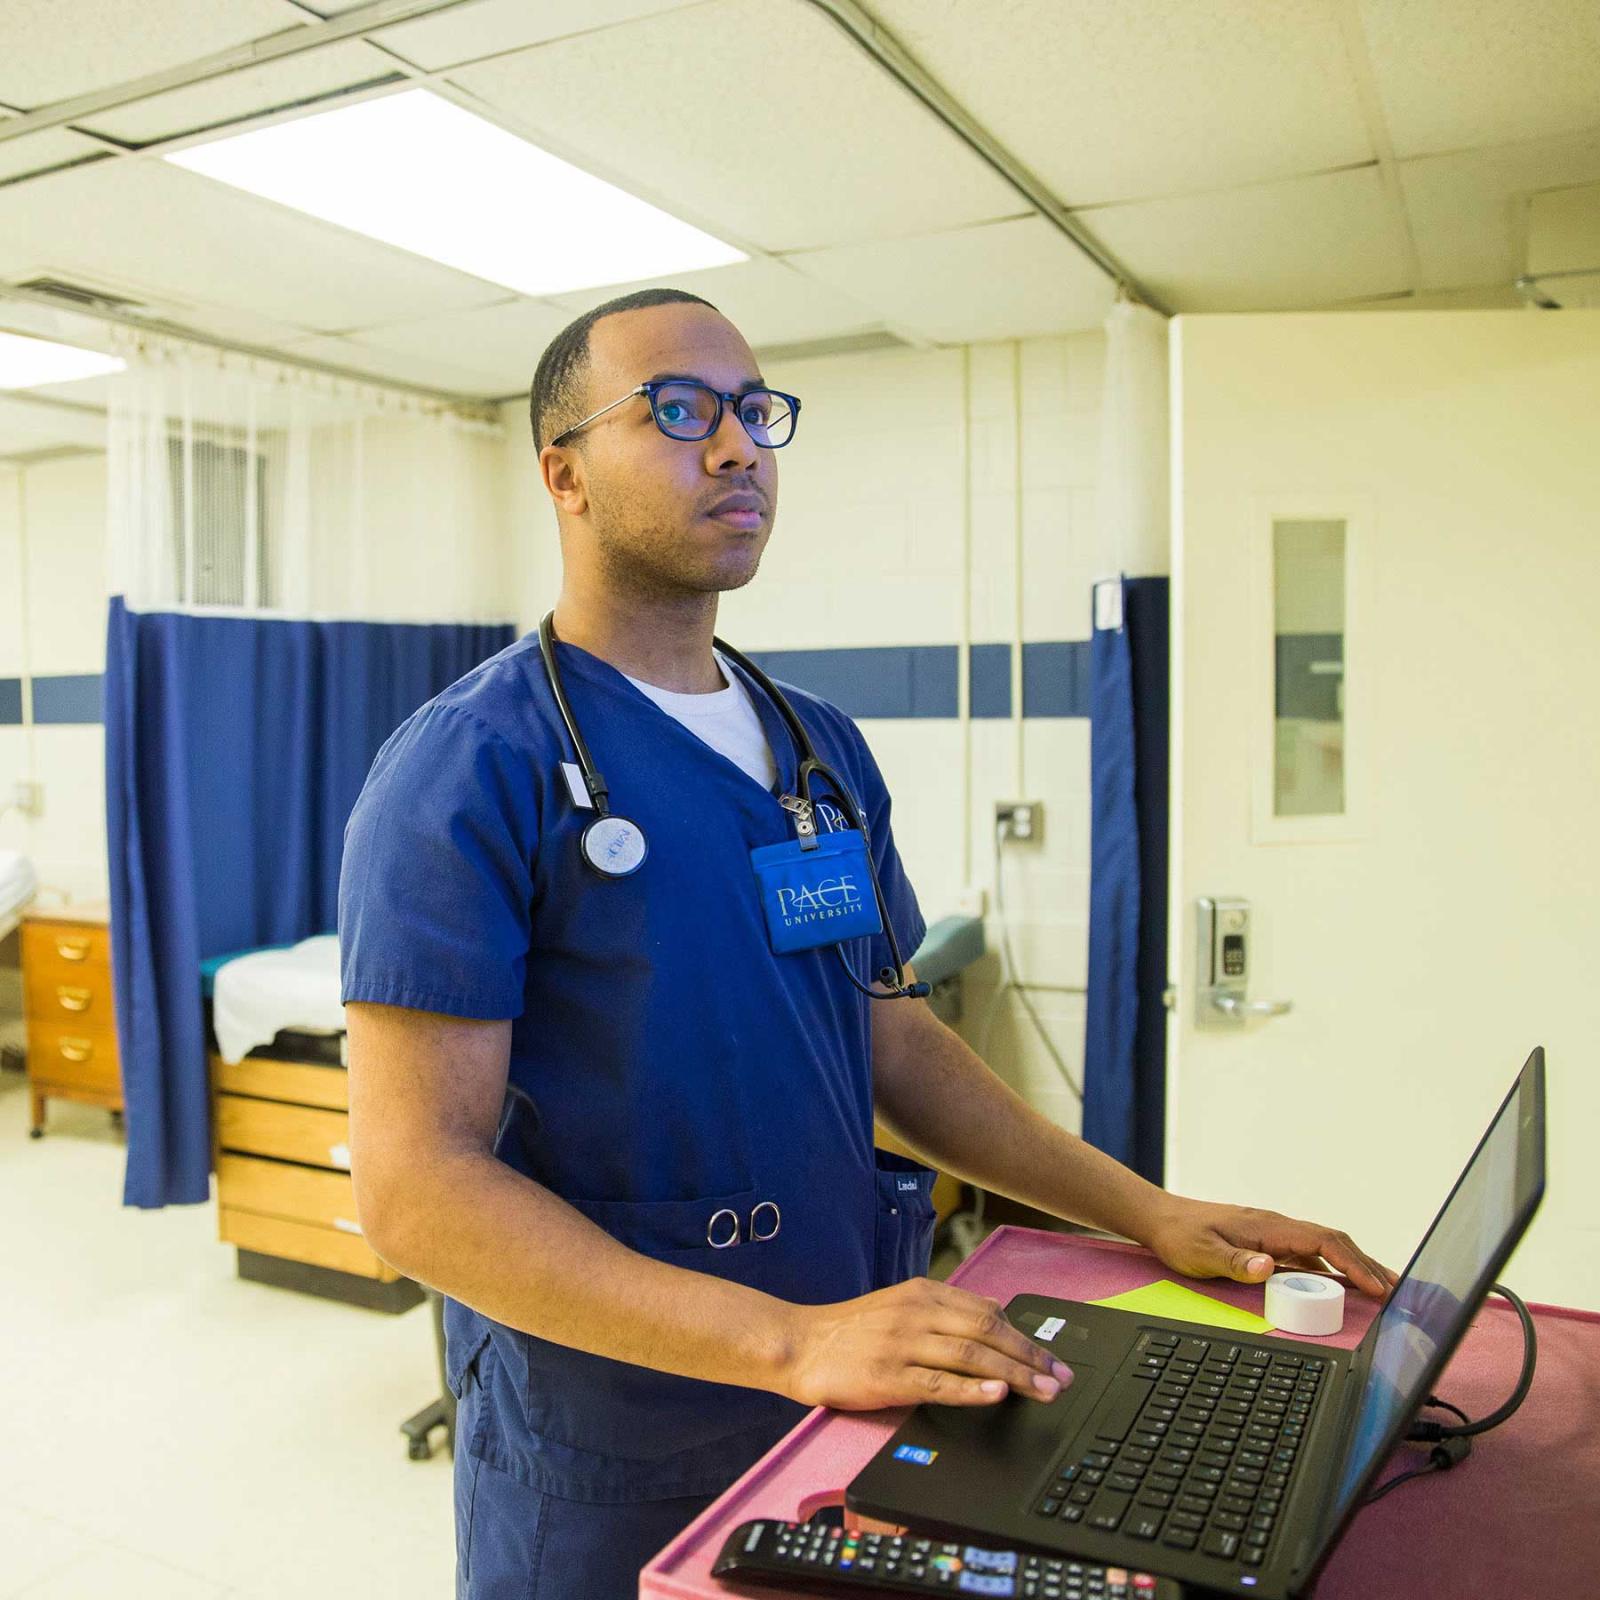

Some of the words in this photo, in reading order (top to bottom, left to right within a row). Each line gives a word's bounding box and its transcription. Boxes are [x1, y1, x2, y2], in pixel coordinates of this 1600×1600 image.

[815, 803, 867, 833] PA
[777, 875, 861, 916] PACE
[785, 903, 863, 926] UNIVERSITY
